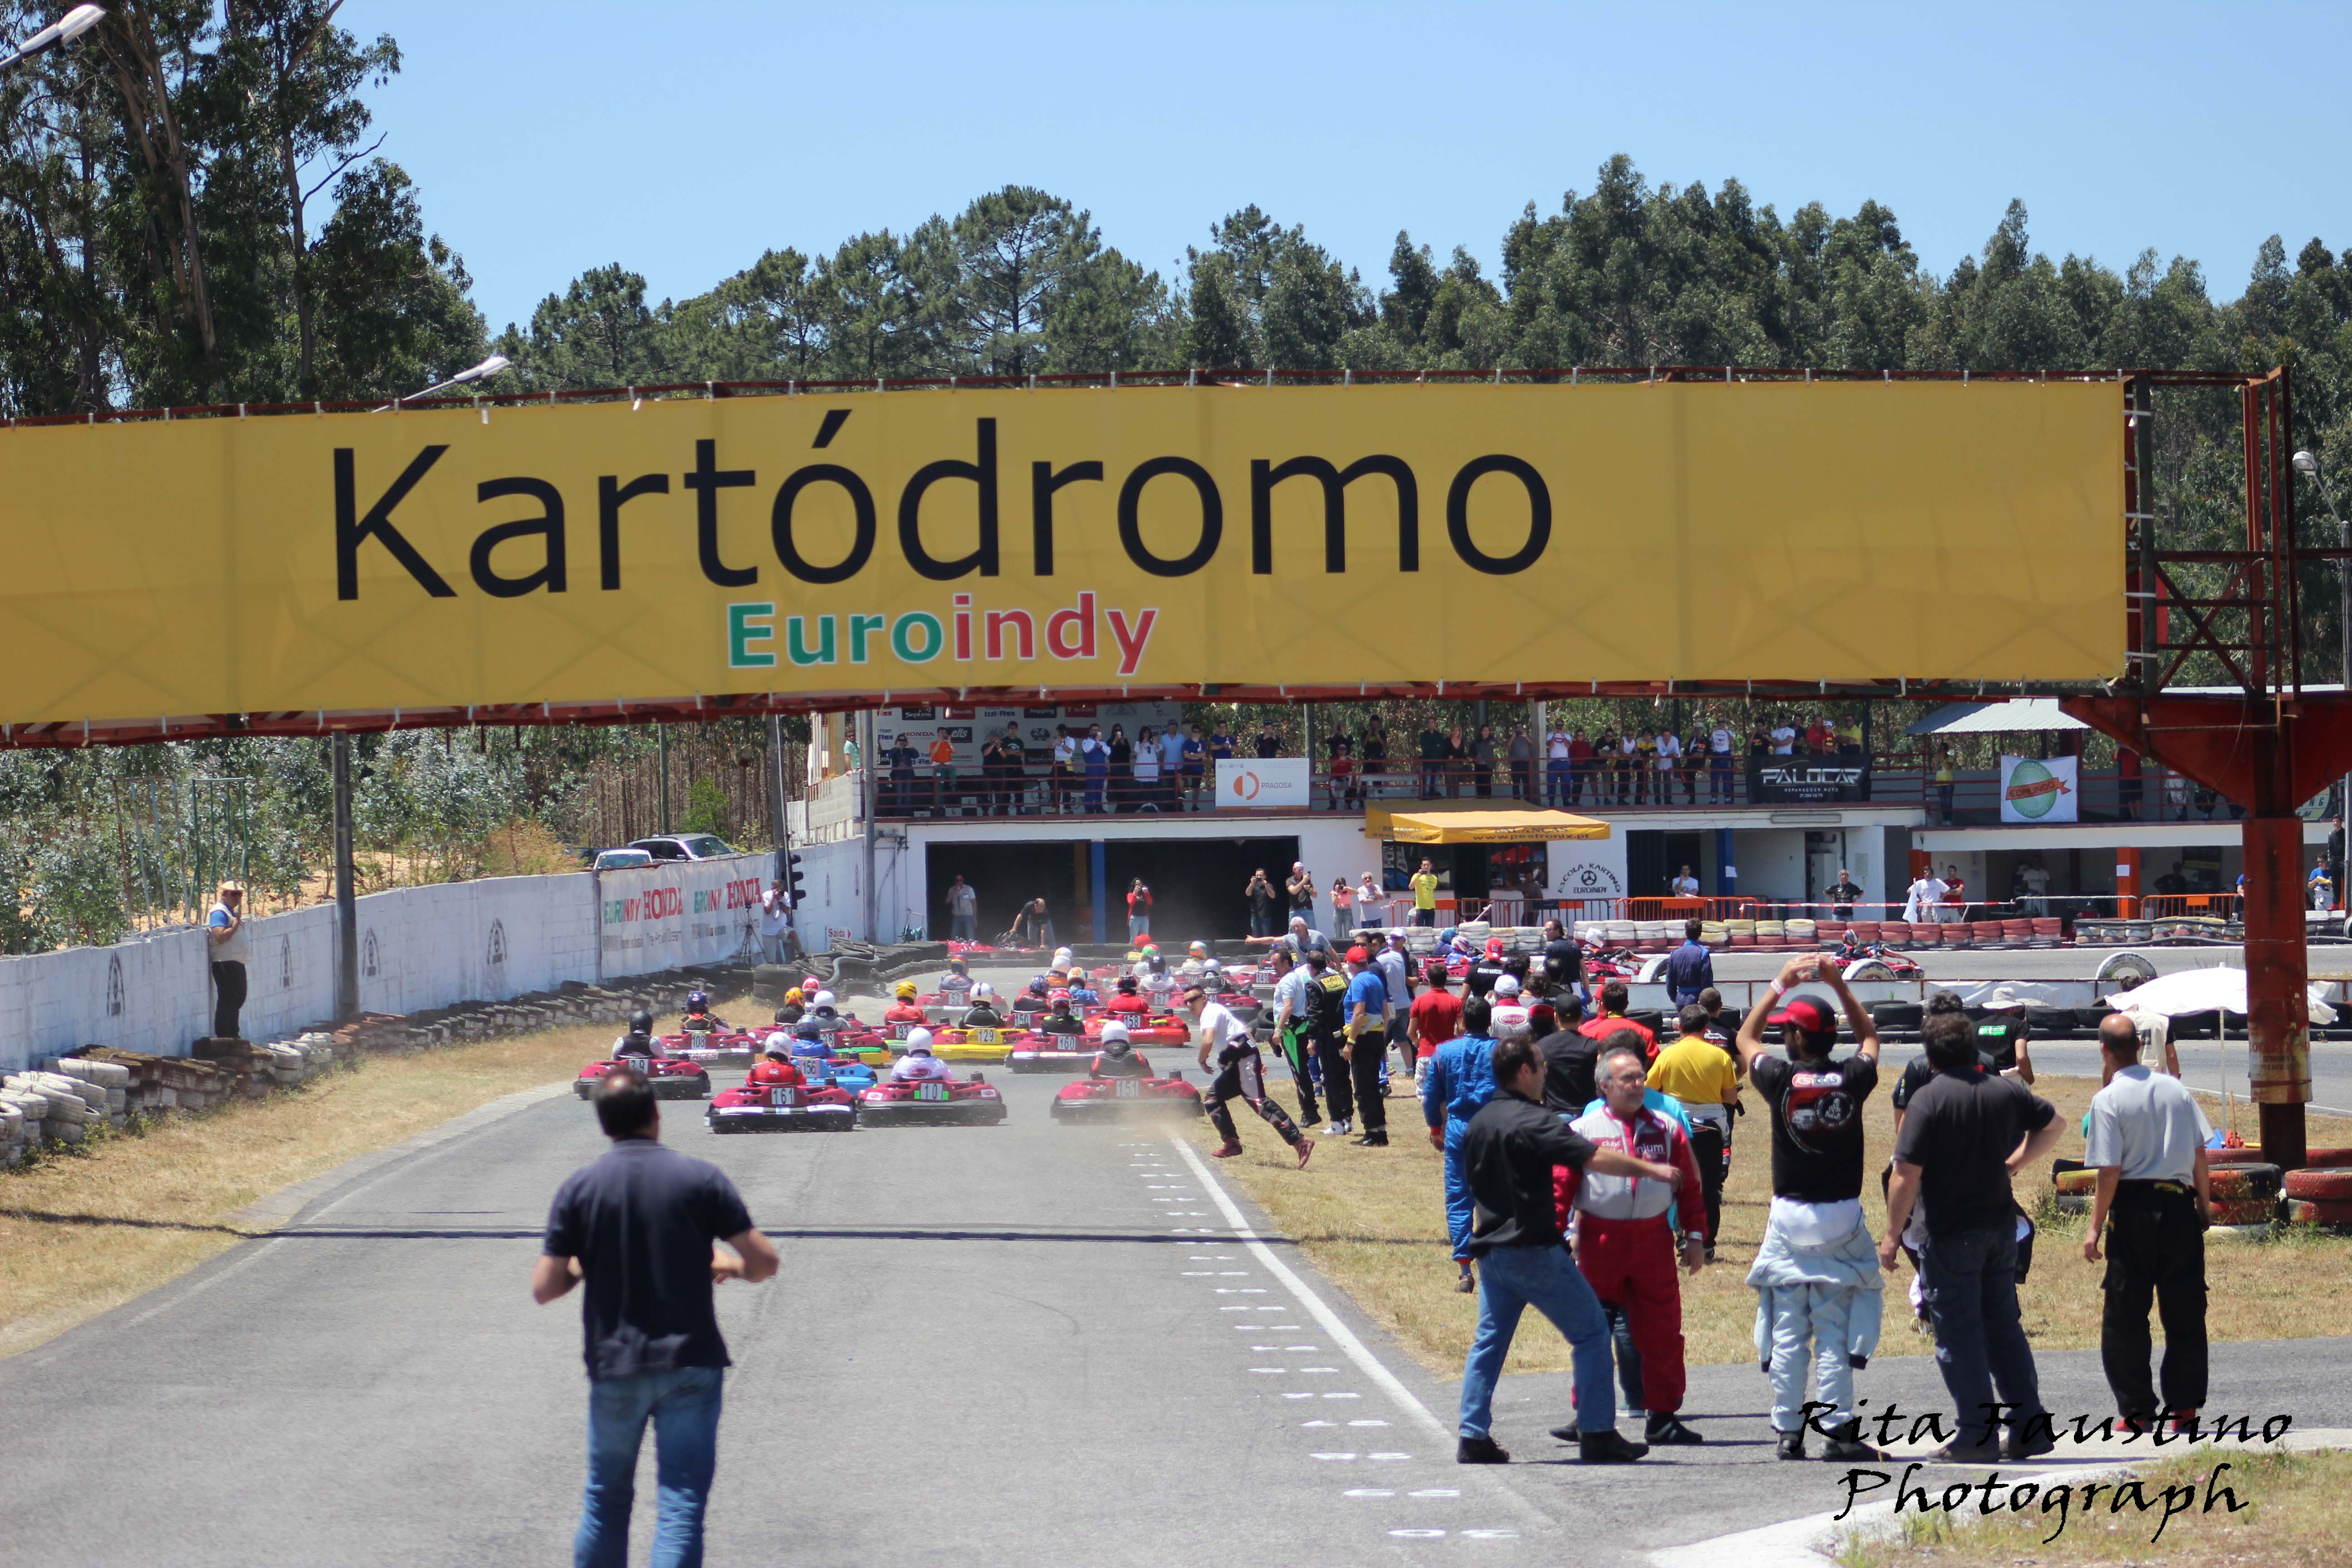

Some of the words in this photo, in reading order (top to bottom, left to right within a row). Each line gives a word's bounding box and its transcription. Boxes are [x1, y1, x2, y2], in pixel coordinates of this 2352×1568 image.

[334, 409, 1552, 601] Kartódromo
[726, 590, 1161, 679] Euroindy
[1558, 864, 1584, 893] ESCOLA
[1589, 863, 1621, 893] KARTING
[951, 993, 960, 1004] 52
[1125, 1015, 1138, 1027] 158
[899, 1025, 908, 1038] 93
[979, 1029, 994, 1042] 129
[692, 1034, 705, 1048] 108
[1059, 1036, 1074, 1049] 160
[802, 1060, 816, 1075] 156
[773, 1088, 793, 1105] 161
[924, 1083, 937, 1100] 10
